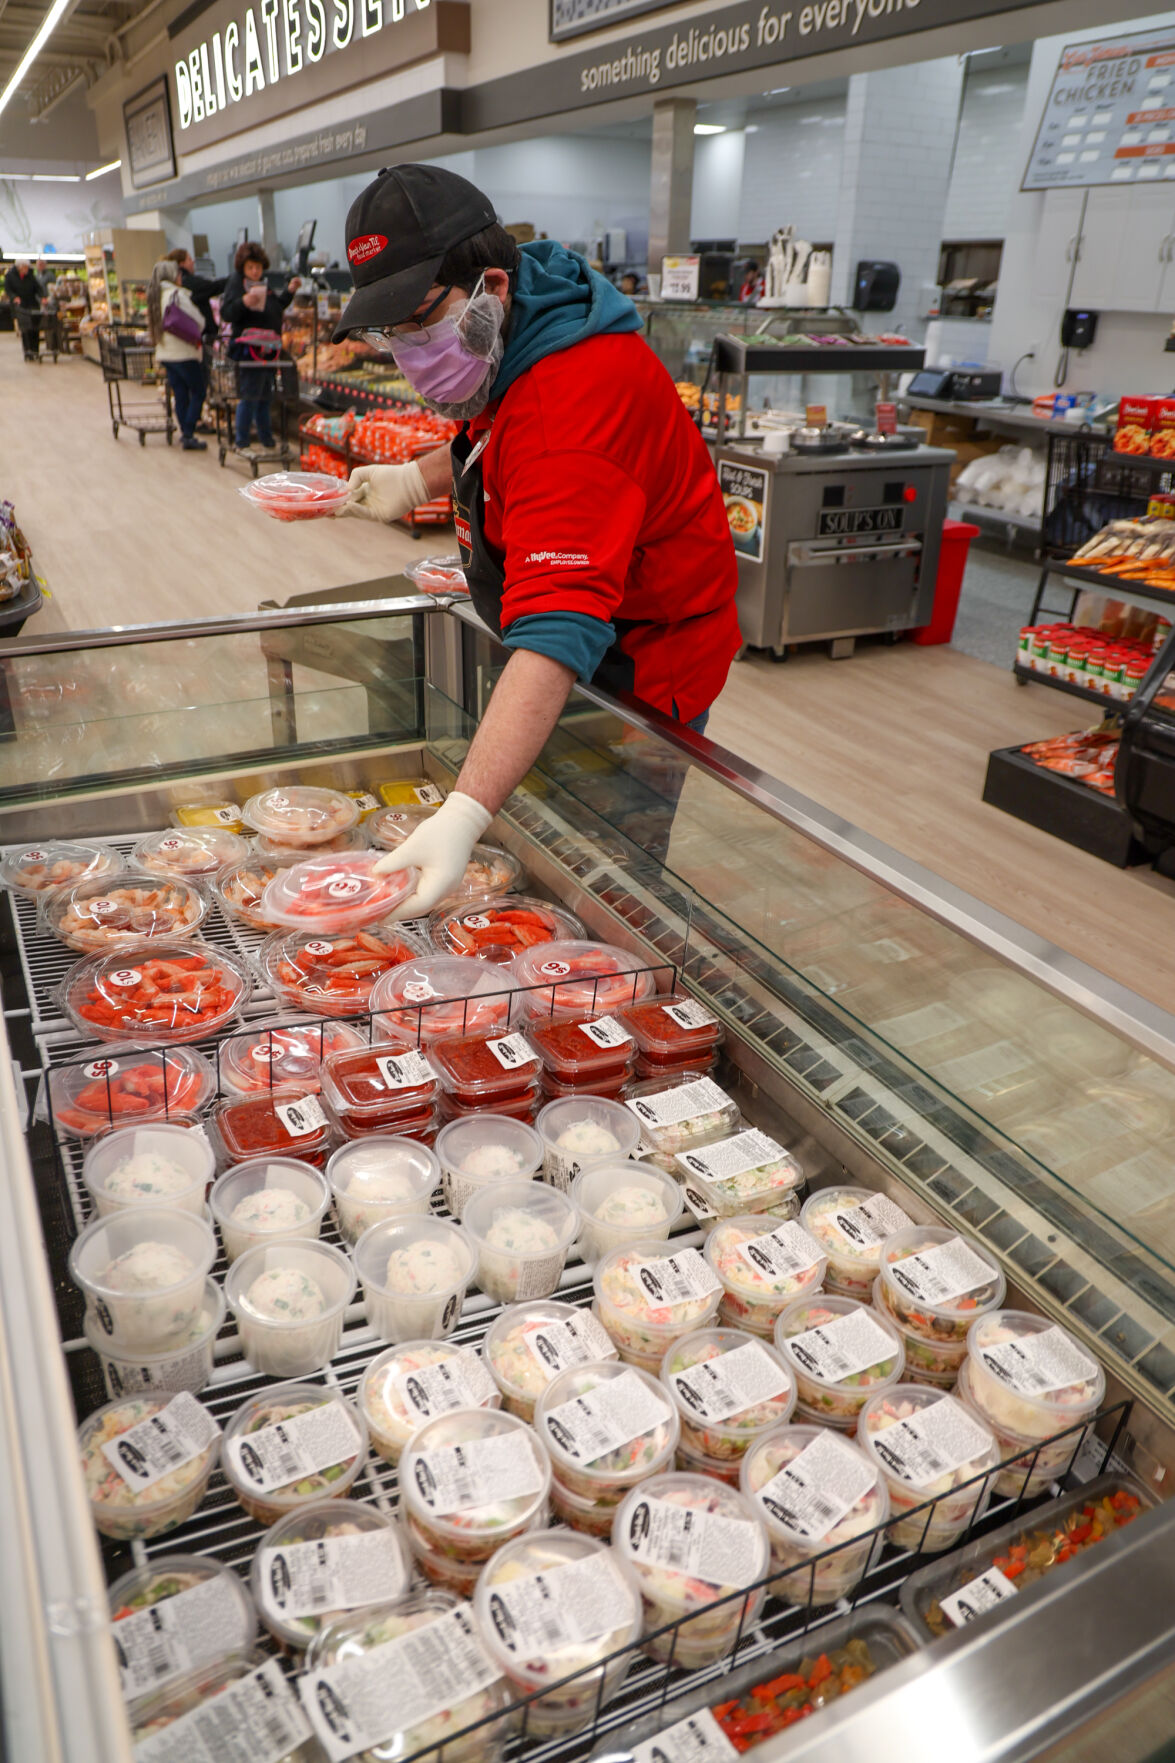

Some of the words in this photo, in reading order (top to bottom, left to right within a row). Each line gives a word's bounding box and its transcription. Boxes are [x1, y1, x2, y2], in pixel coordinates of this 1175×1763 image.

[580, 46, 661, 92] something
[665, 23, 750, 70] delicious
[756, 6, 792, 48] for
[1086, 58, 1141, 82] FRIED
[1053, 79, 1136, 105] CHICKEN
[877, 509, 896, 529] ON
[544, 962, 568, 974] $6
[255, 1045, 283, 1059] $6
[91, 1060, 113, 1078] $6
